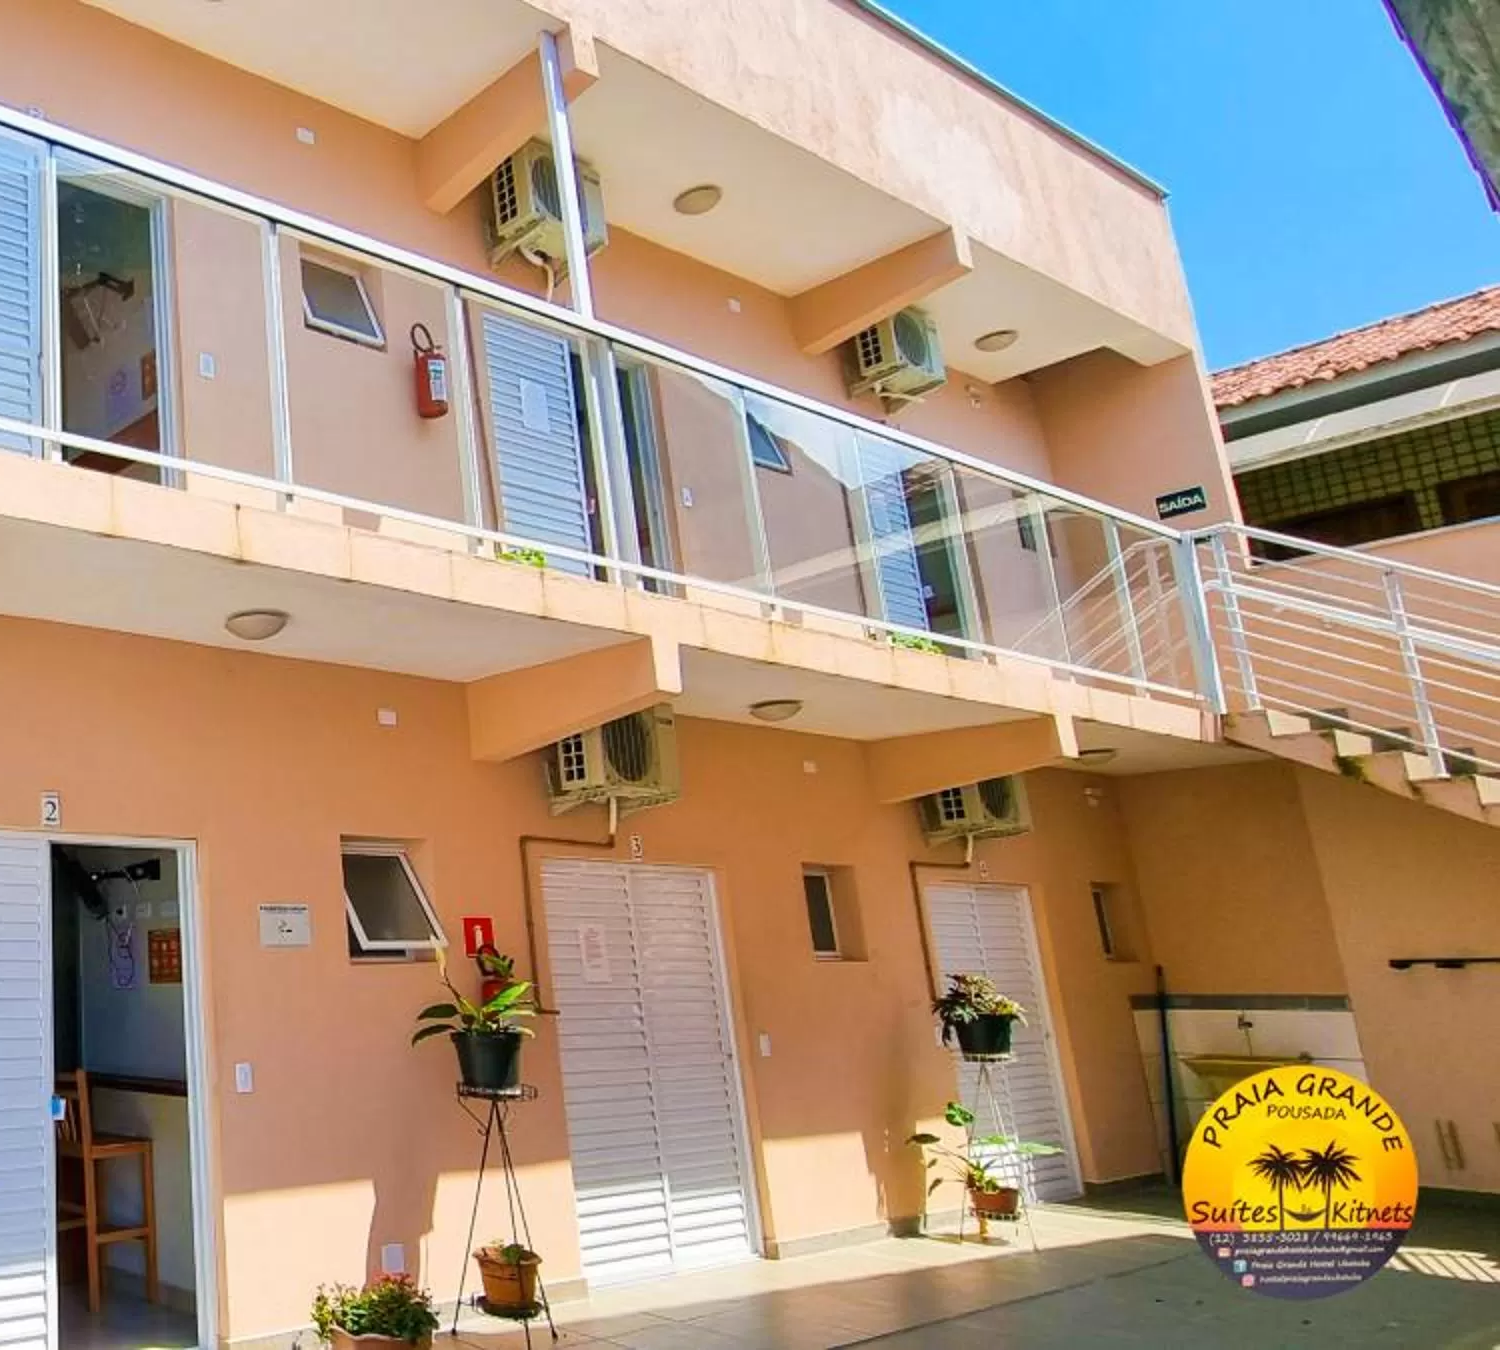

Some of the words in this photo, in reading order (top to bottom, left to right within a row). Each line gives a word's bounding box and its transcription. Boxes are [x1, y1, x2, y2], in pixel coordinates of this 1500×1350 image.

[1158, 493, 1203, 514] SAÍDA
[45, 800, 57, 821] 2
[631, 836, 642, 853] 3
